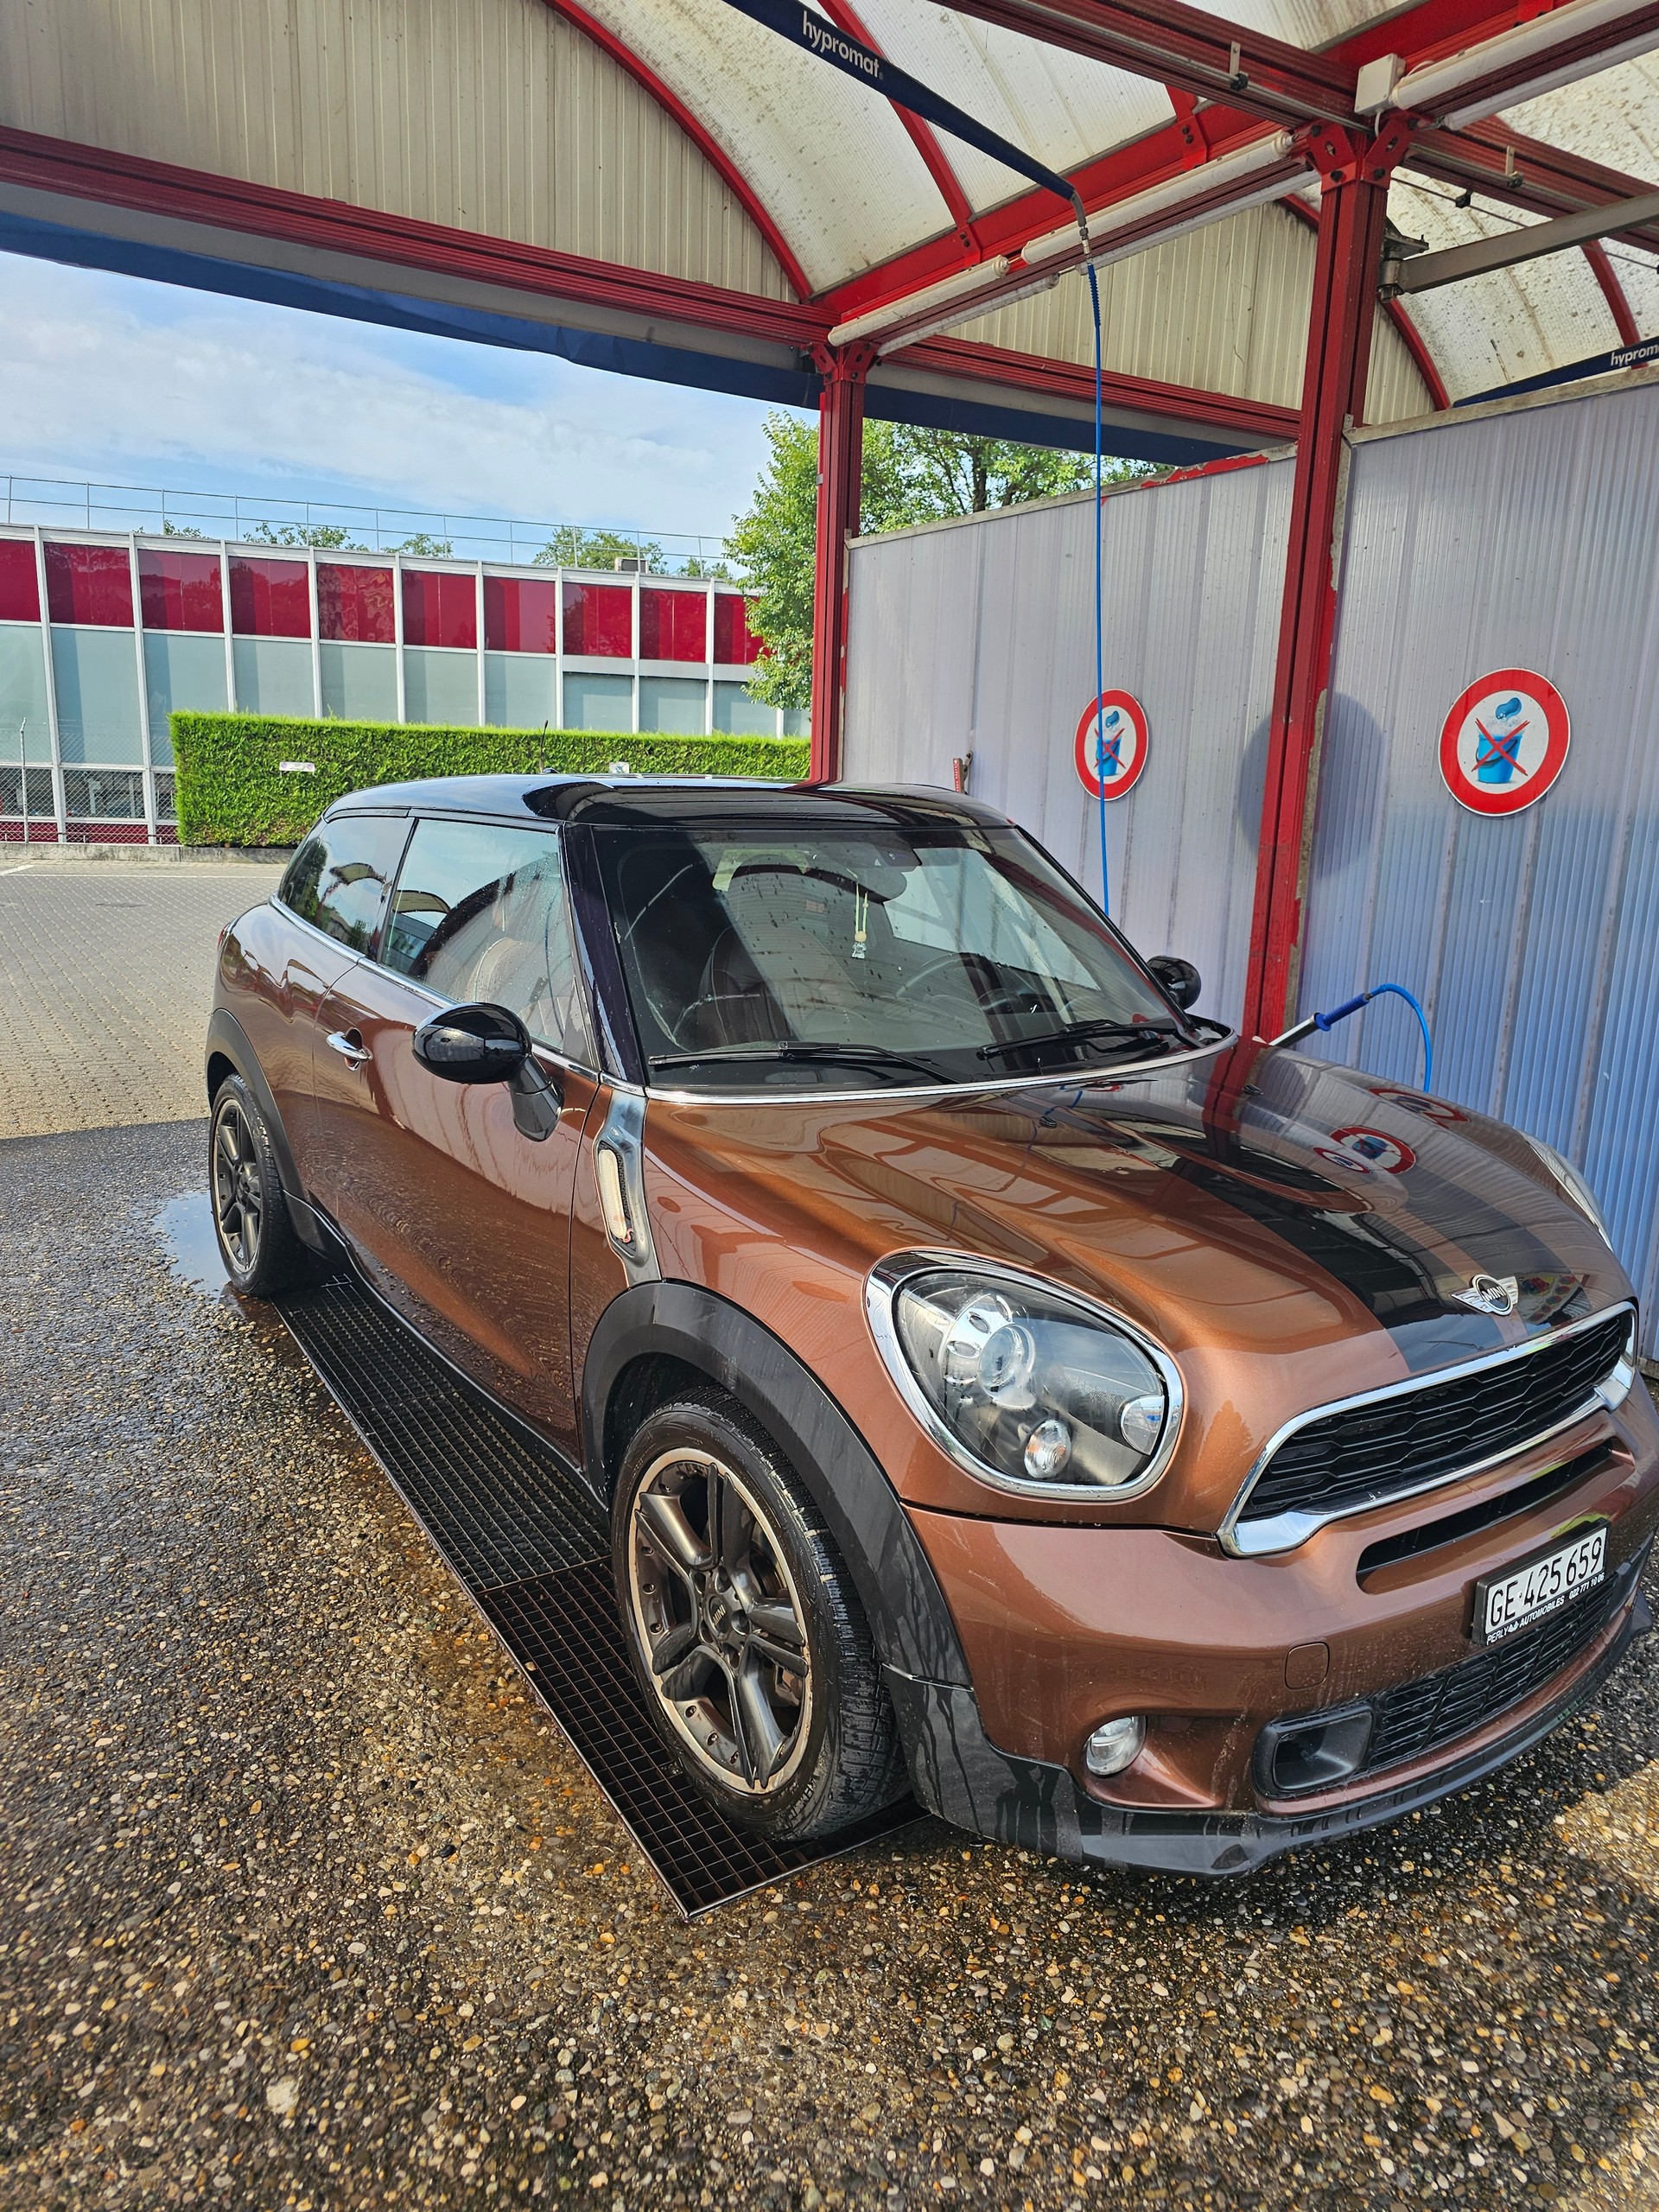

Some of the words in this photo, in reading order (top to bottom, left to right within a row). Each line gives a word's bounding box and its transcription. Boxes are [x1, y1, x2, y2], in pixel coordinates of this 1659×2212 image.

[803, 10, 879, 78] hypromat
[1611, 345, 1659, 366] hyprom
[1481, 1286, 1506, 1301] MINI
[713, 1604, 726, 1624] MINI
[1486, 1626, 1510, 1646] PERLY
[1519, 1595, 1565, 1628] AUTOMOBILES
